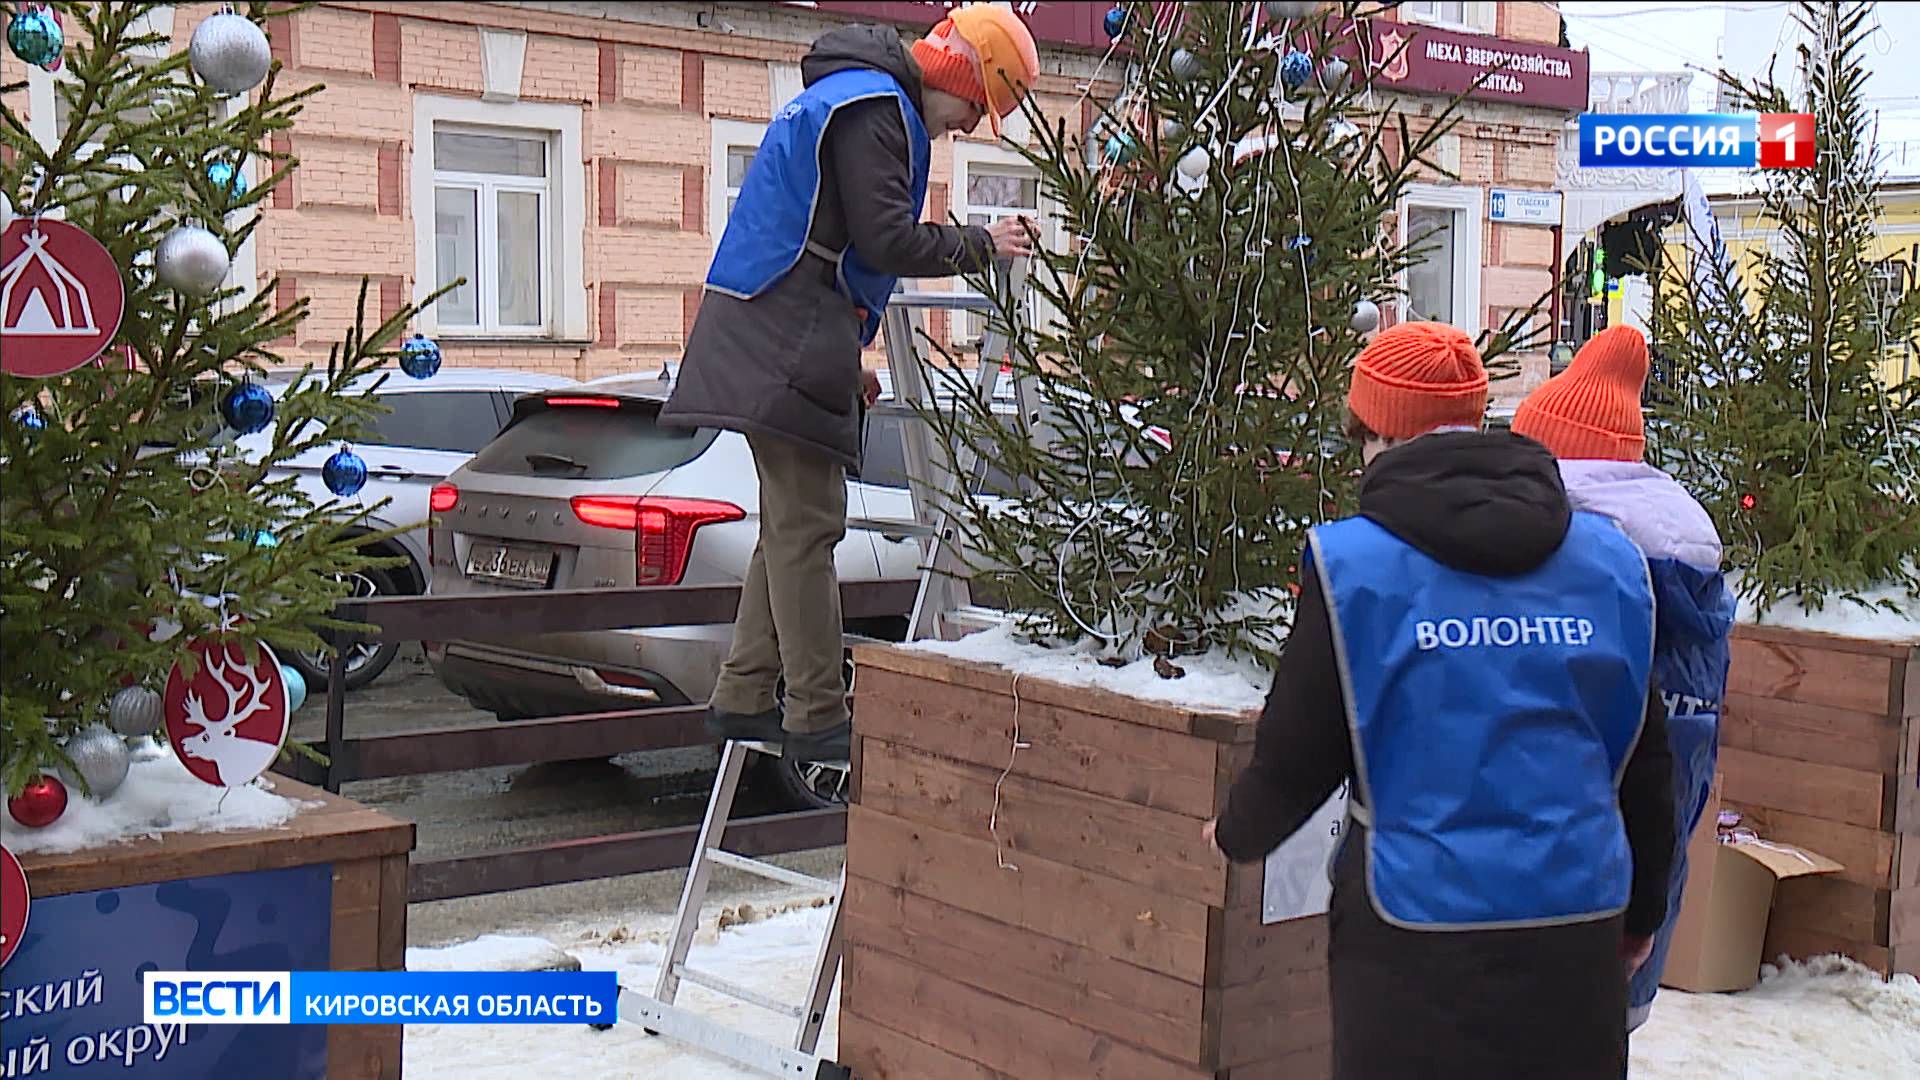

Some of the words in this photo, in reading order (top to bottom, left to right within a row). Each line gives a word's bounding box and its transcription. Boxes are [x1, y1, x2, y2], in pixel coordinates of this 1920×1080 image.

[1426, 40, 1462, 62] МЕХА
[1465, 47, 1572, 78] ЗВЕРОХОЗЯЙСТВА
[1493, 197, 1504, 213] 19
[1416, 617, 1593, 650] ВОЛОНТЕР
